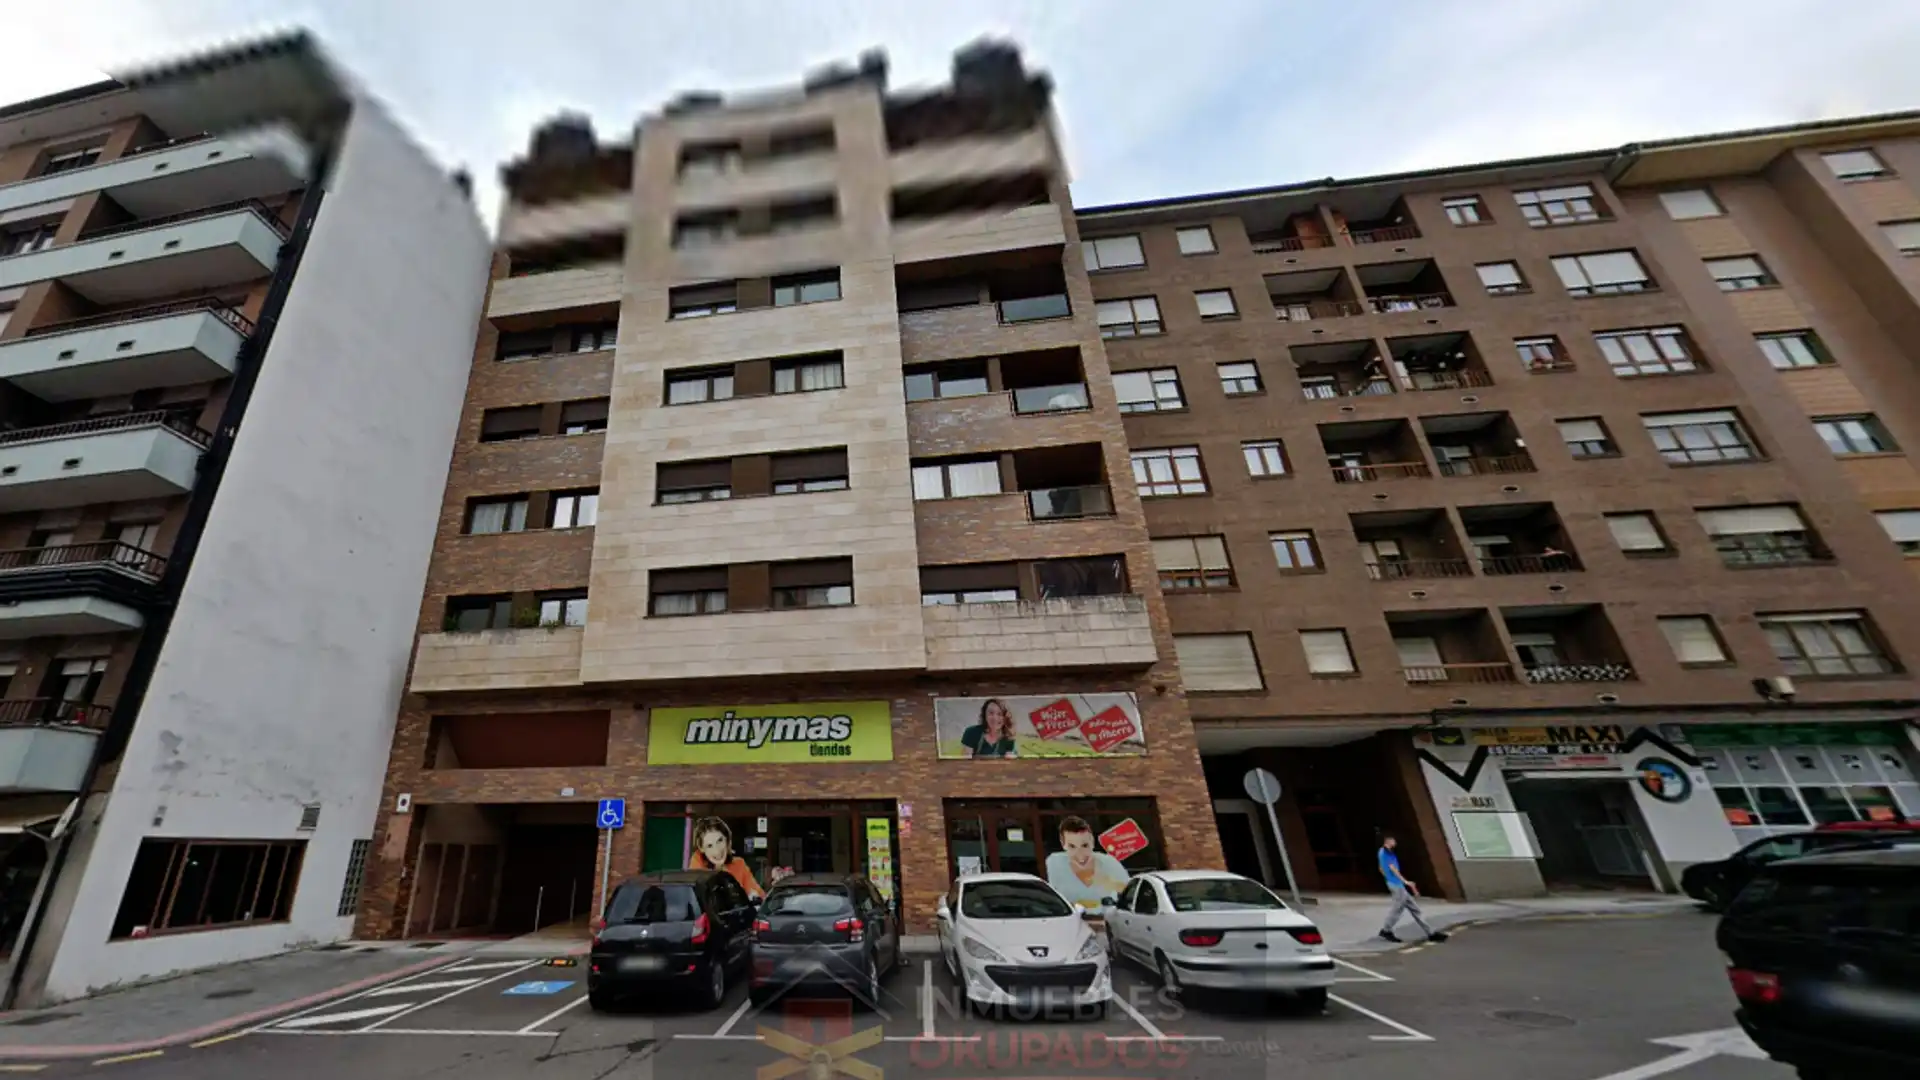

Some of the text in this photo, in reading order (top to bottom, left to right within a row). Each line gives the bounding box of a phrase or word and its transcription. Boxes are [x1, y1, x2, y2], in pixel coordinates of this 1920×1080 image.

[685, 710, 853, 749] minymas
[1545, 724, 1625, 744] MAXI
[810, 743, 852, 757] tiendas
